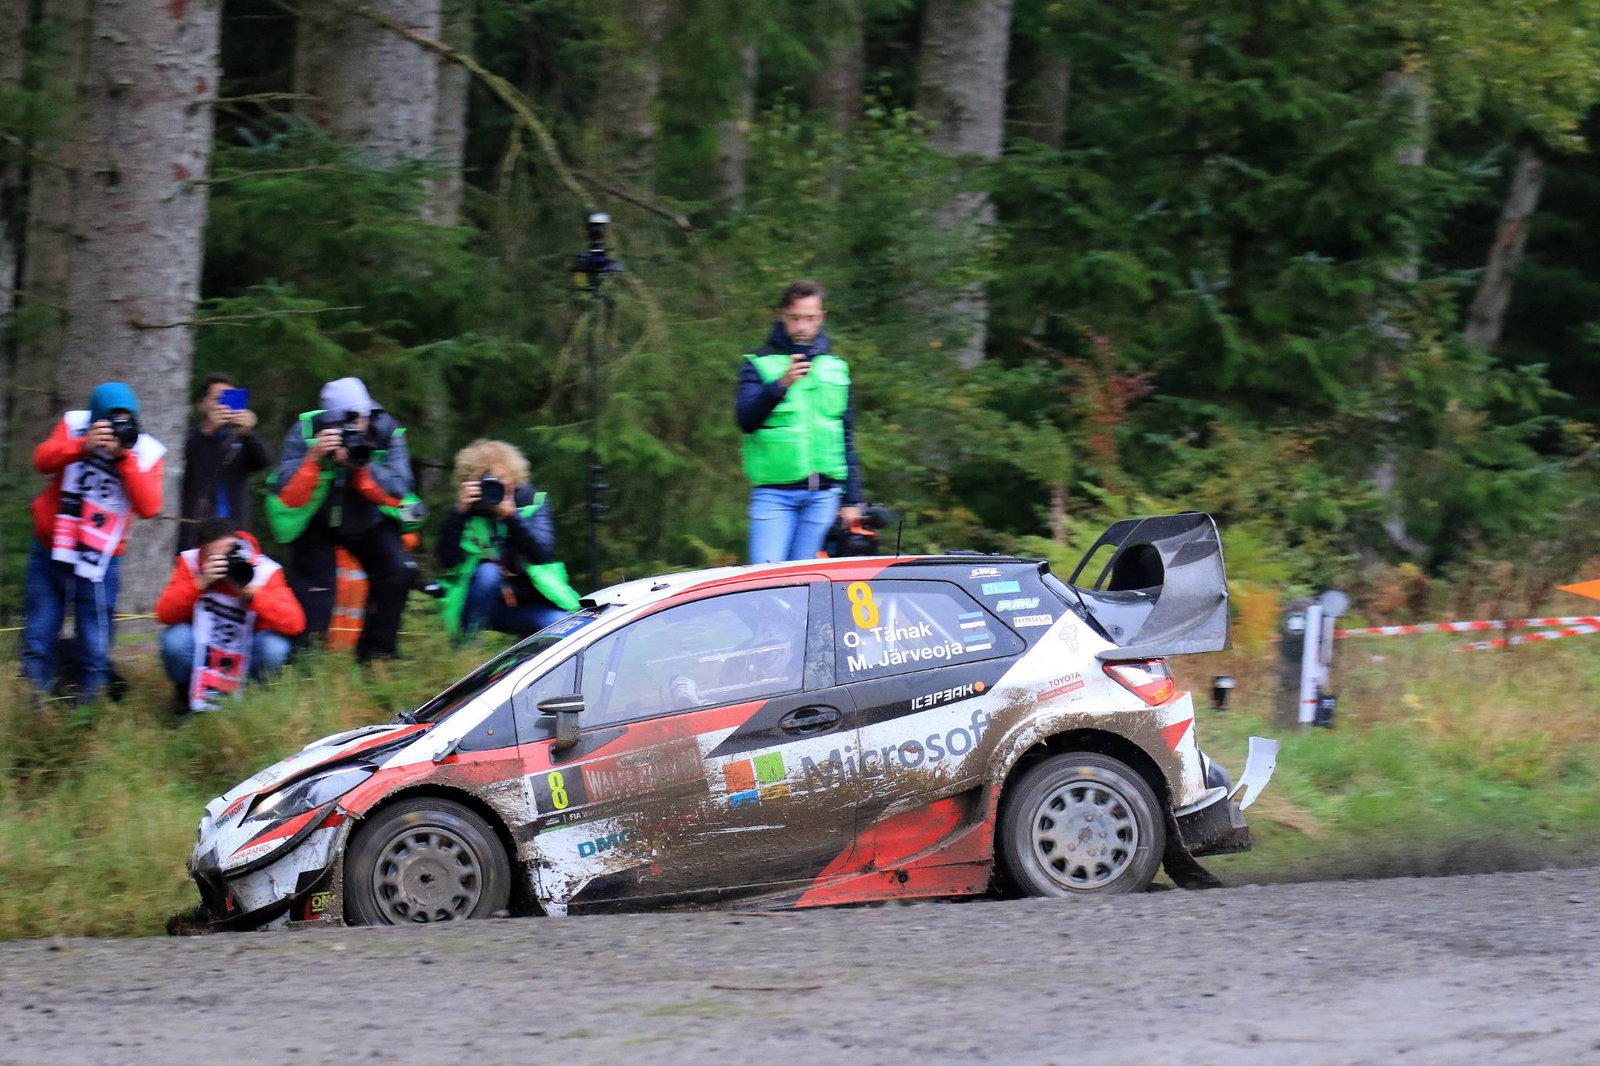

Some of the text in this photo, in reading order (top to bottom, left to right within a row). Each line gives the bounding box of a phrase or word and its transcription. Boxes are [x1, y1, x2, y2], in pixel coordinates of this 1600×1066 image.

[847, 582, 879, 629] 8
[1014, 615, 1051, 624] NISULA
[843, 621, 933, 649] O. Tänak
[847, 639, 964, 673] M. Järveoja
[1048, 671, 1082, 688] TOYOTA
[547, 771, 569, 809] 8
[229, 803, 245, 821] MORI
[569, 811, 582, 822] FIA
